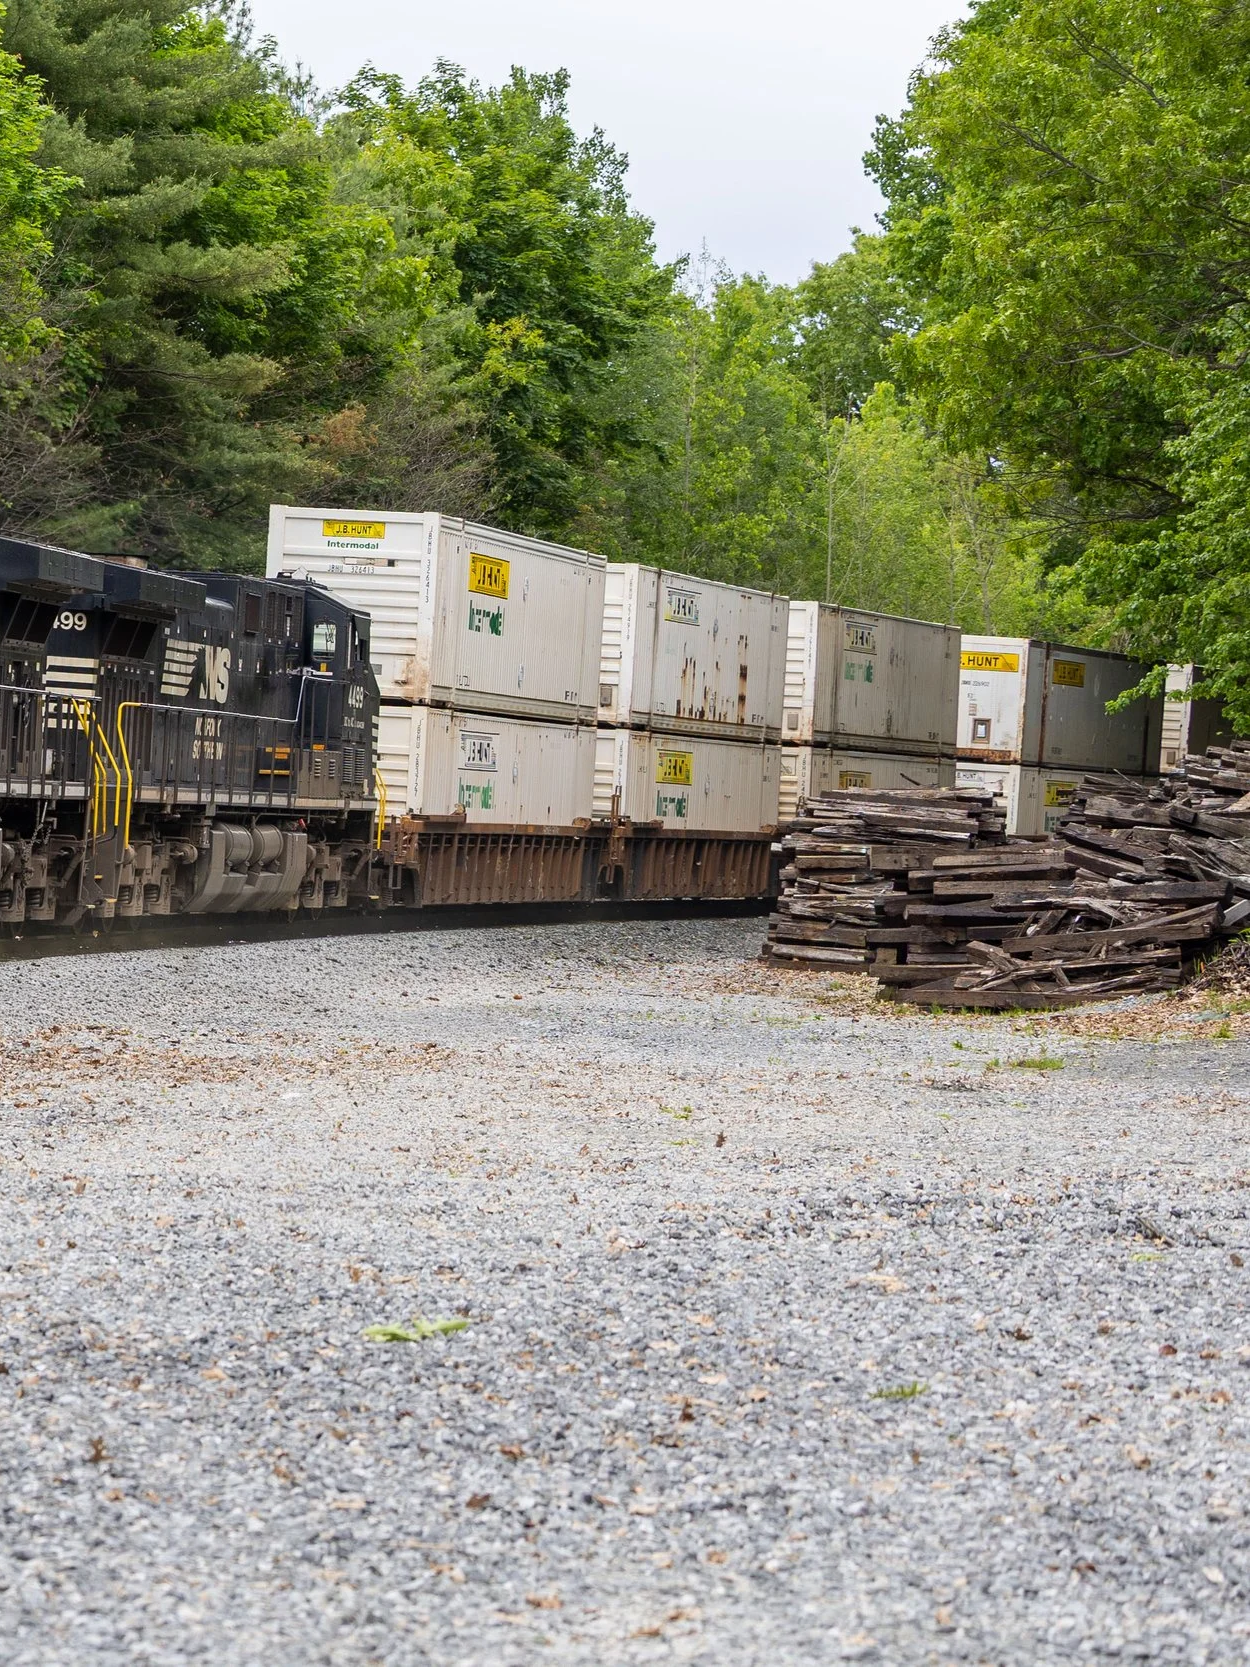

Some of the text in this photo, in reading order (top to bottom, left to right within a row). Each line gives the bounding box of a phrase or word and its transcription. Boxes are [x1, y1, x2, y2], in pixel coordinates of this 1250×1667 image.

[336, 525, 372, 535] J.B. HUNT
[327, 540, 379, 550] Intermodal
[350, 565, 375, 575] 326413
[967, 656, 999, 667] HUNT
[198, 644, 232, 704] NS
